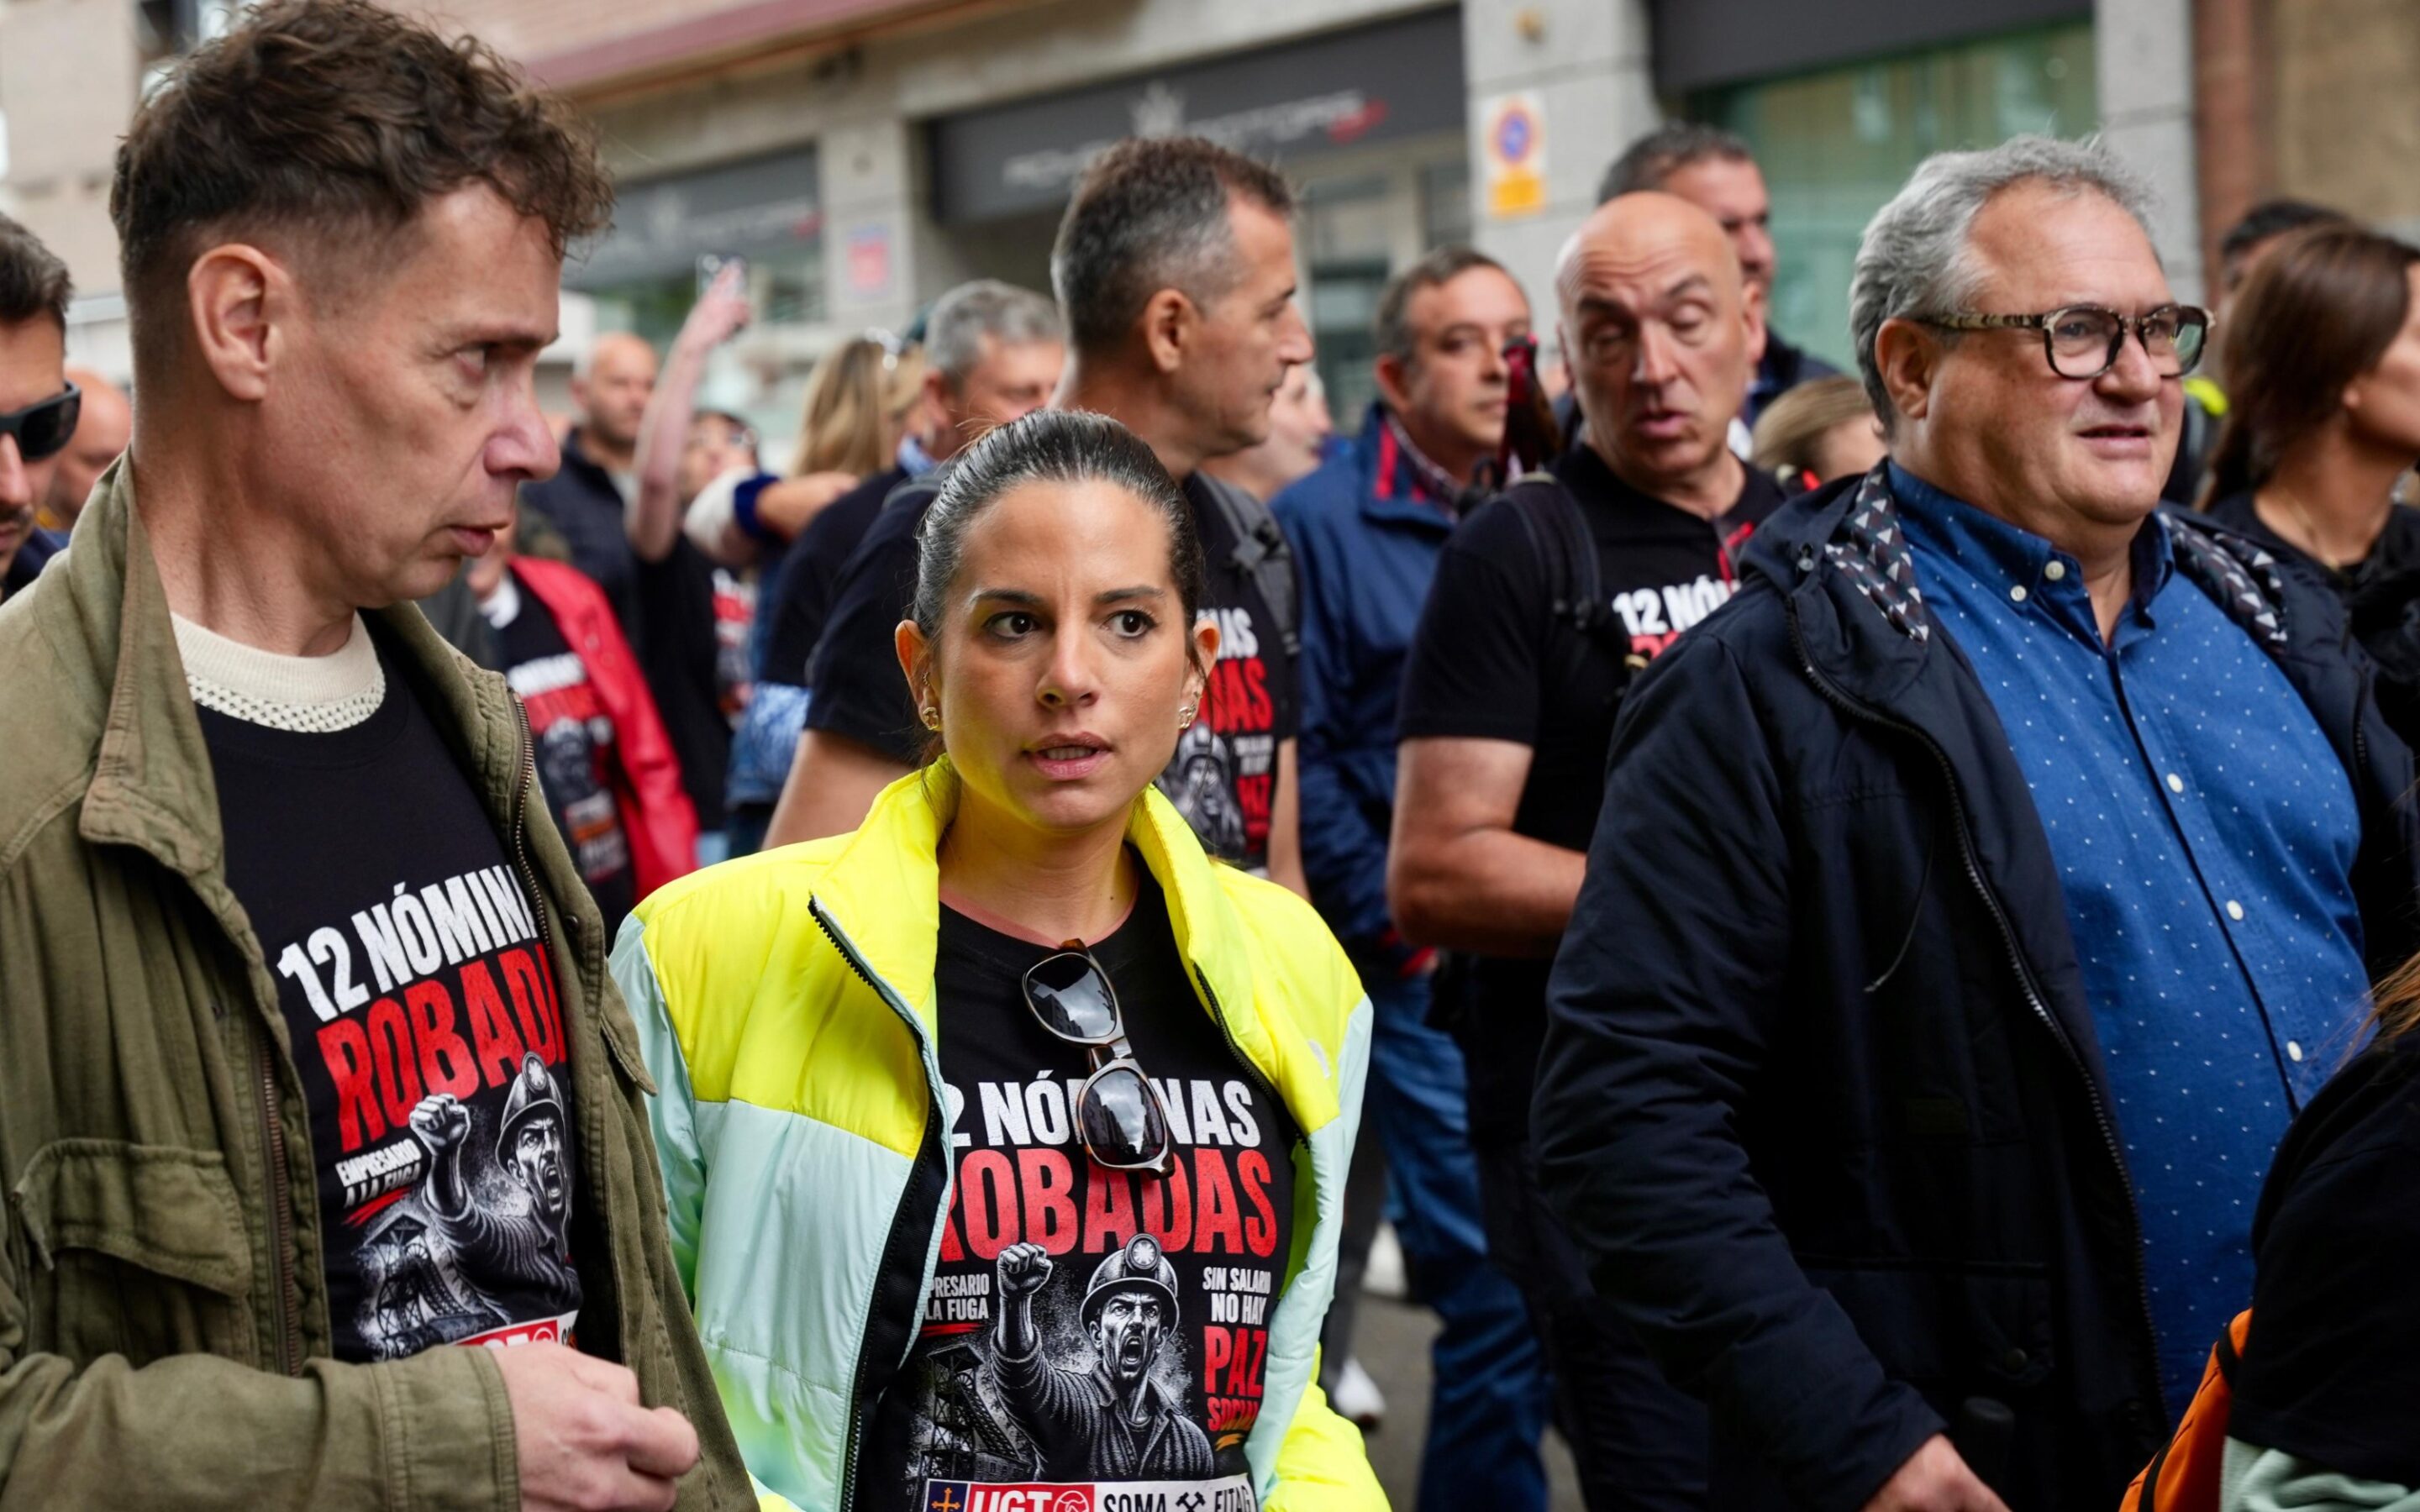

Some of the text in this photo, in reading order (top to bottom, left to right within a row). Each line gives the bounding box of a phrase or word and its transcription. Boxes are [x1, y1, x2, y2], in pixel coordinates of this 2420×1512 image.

[1612, 588, 1669, 636] 12
[277, 864, 539, 1022] 12 NÓMIN
[315, 942, 567, 1154] ROBAD
[1202, 1267, 1228, 1291] SIN
[947, 1297, 989, 1321] FUGA
[1211, 1293, 1267, 1326] NO HAY
[1203, 1326, 1267, 1399] PAZ
[1103, 1493, 1166, 1512] SOMA
